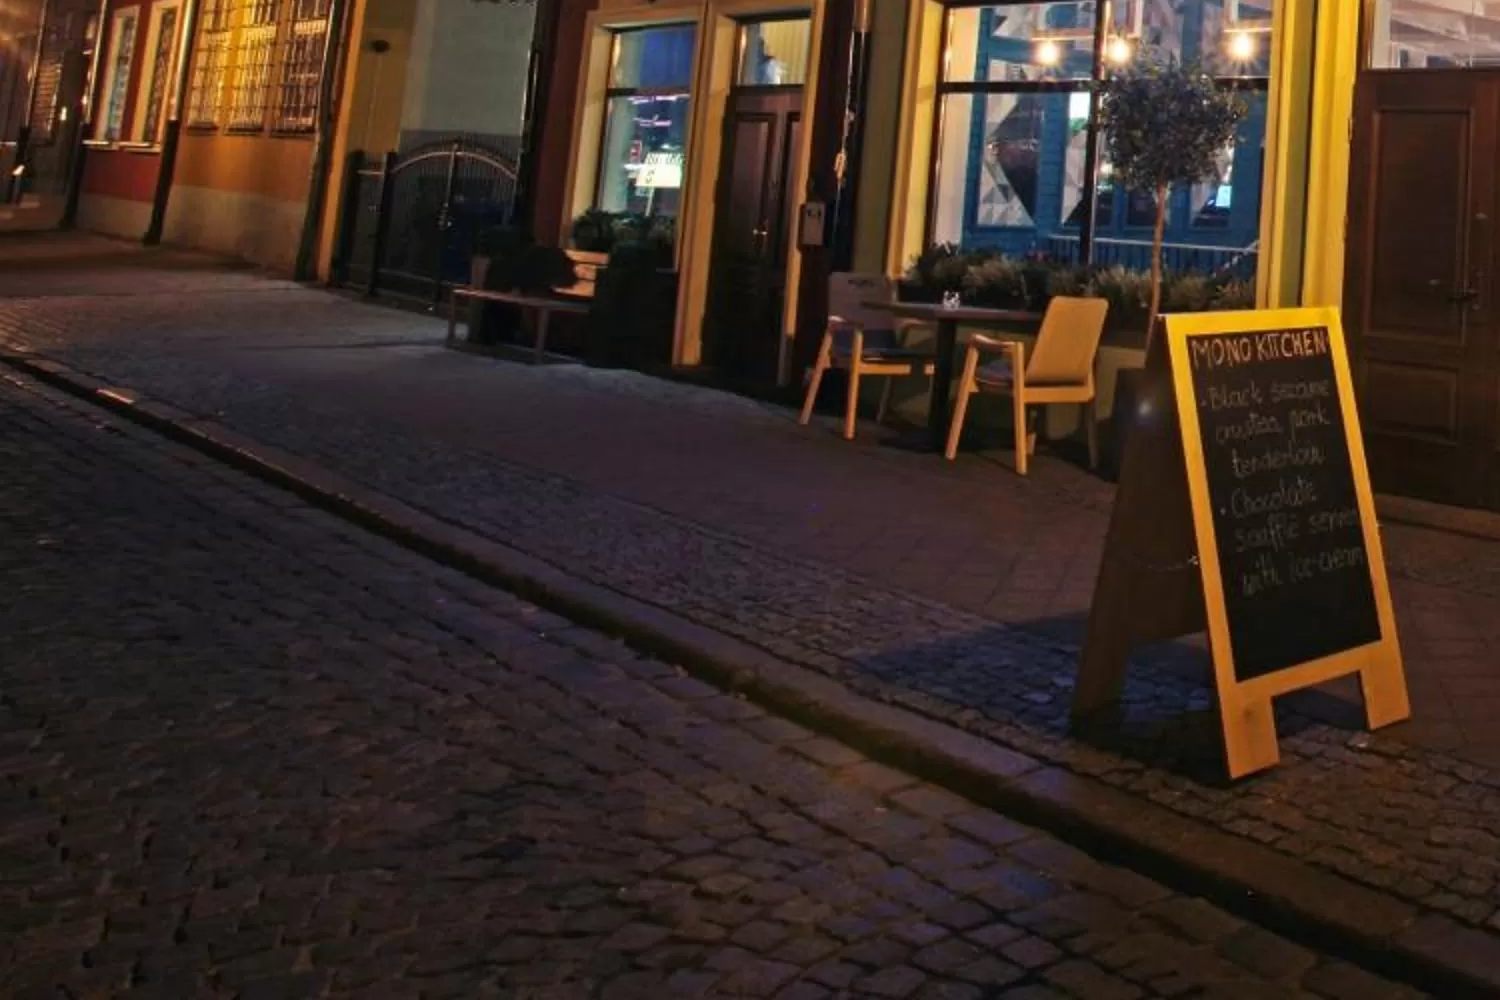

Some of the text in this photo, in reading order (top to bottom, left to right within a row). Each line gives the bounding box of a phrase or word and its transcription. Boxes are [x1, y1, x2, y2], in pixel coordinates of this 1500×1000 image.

[1191, 329, 1328, 369] MONO KITCHEN
[1208, 379, 1263, 410] Black
